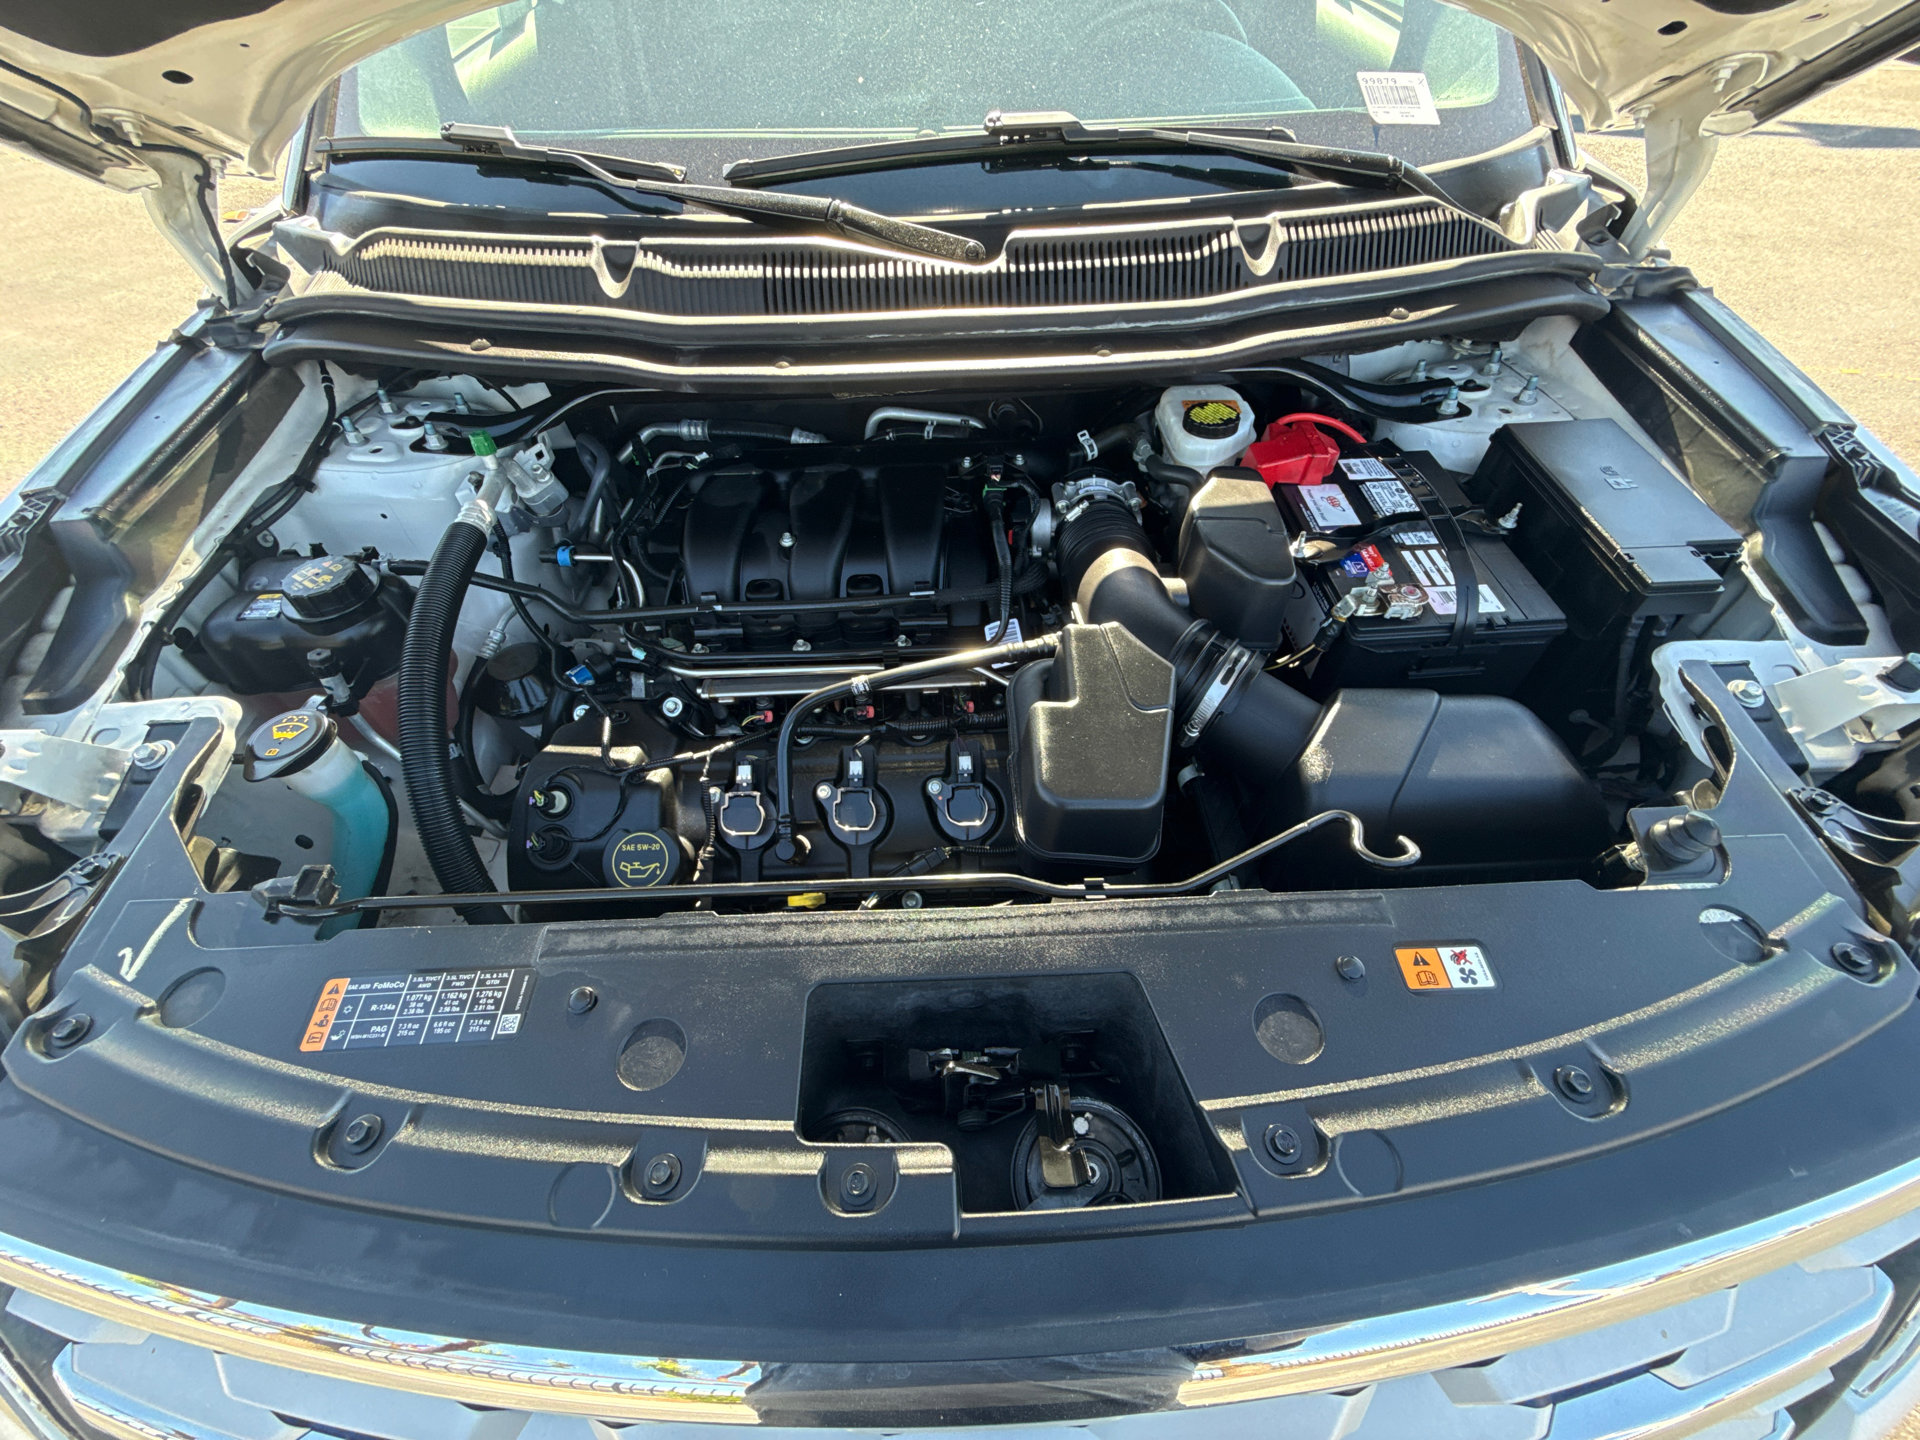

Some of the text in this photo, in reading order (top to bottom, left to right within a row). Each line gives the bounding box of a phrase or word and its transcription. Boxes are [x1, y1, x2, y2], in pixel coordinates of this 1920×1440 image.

[637, 843, 661, 851] 5W-20
[373, 981, 405, 989] FoMoCo
[423, 994, 432, 1002] kg
[441, 992, 468, 1000] 1.162 kg
[493, 990, 503, 998] kg
[370, 1003, 396, 1011] R-134a
[370, 1025, 388, 1033] PAG
